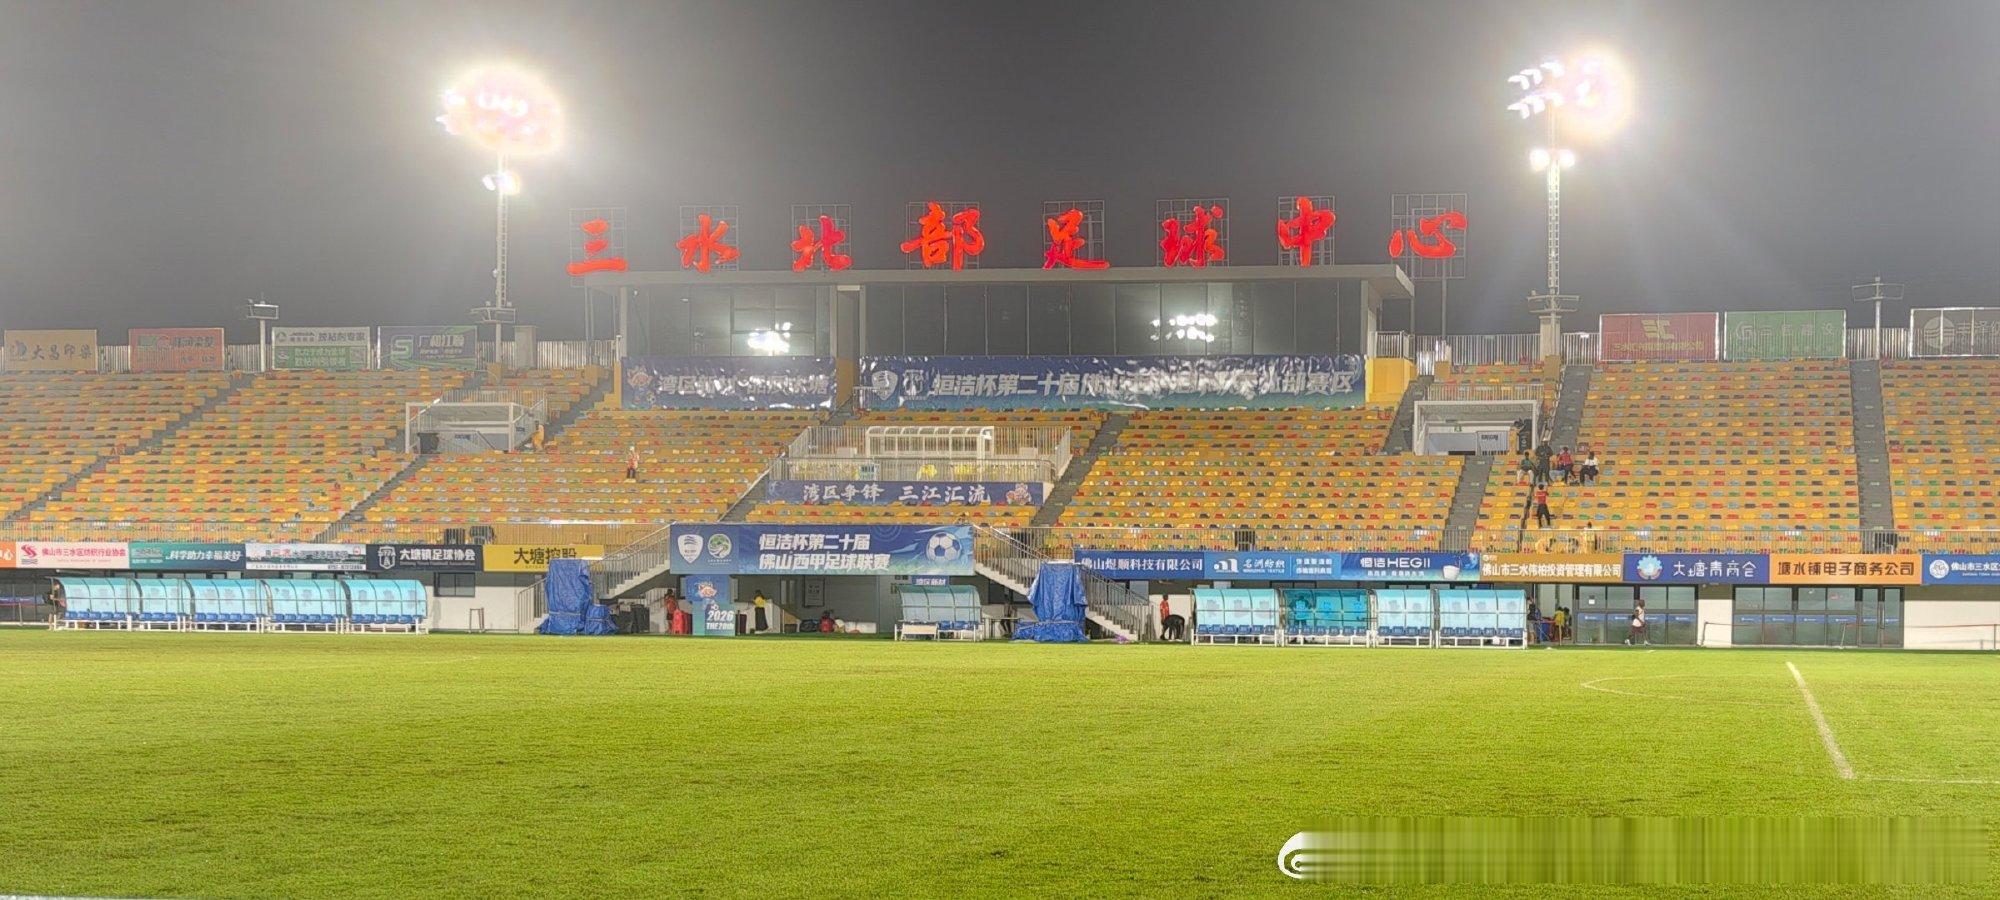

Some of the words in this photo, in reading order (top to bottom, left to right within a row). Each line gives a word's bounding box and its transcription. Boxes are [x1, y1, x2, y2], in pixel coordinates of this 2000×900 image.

[566, 197, 1467, 275] 三水北部足球中心
[33, 344, 91, 359] 大昌印染
[803, 484, 885, 501] 湾区争锋
[898, 485, 991, 503] 三江汇流
[759, 533, 871, 551] 恒洁杯第二十届
[513, 547, 578, 565] 大塘控股
[759, 553, 891, 571] 佛山西甲足球联赛
[1360, 557, 1385, 568] 恒洁
[1387, 557, 1431, 568] HEGII
[1950, 562, 2000, 571] 佛山市三水区
[707, 611, 734, 621] 2026
